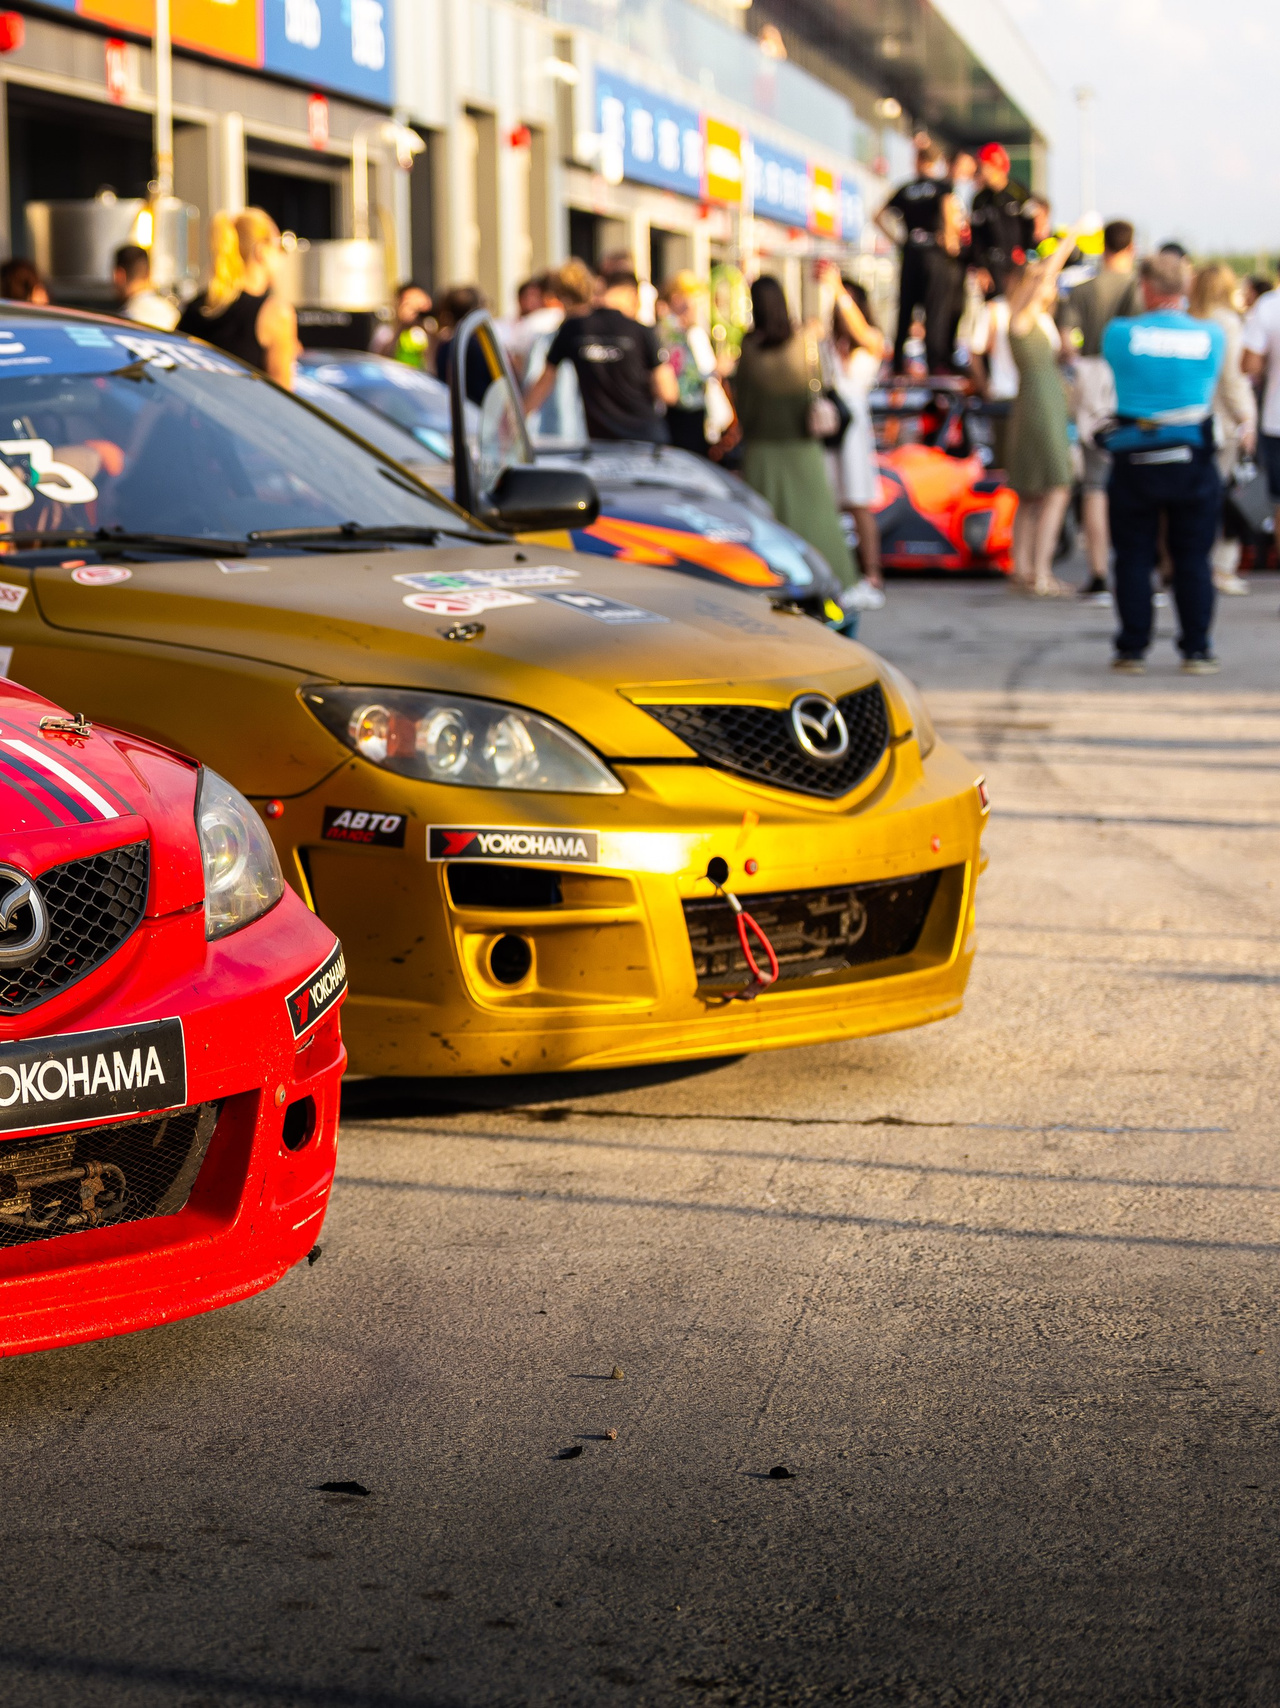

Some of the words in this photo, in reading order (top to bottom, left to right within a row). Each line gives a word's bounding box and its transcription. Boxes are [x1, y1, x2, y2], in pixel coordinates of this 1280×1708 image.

[332, 809, 402, 833] АВТО
[477, 832, 589, 858] YOKOHAMA
[309, 952, 347, 1009] YOKOHAM
